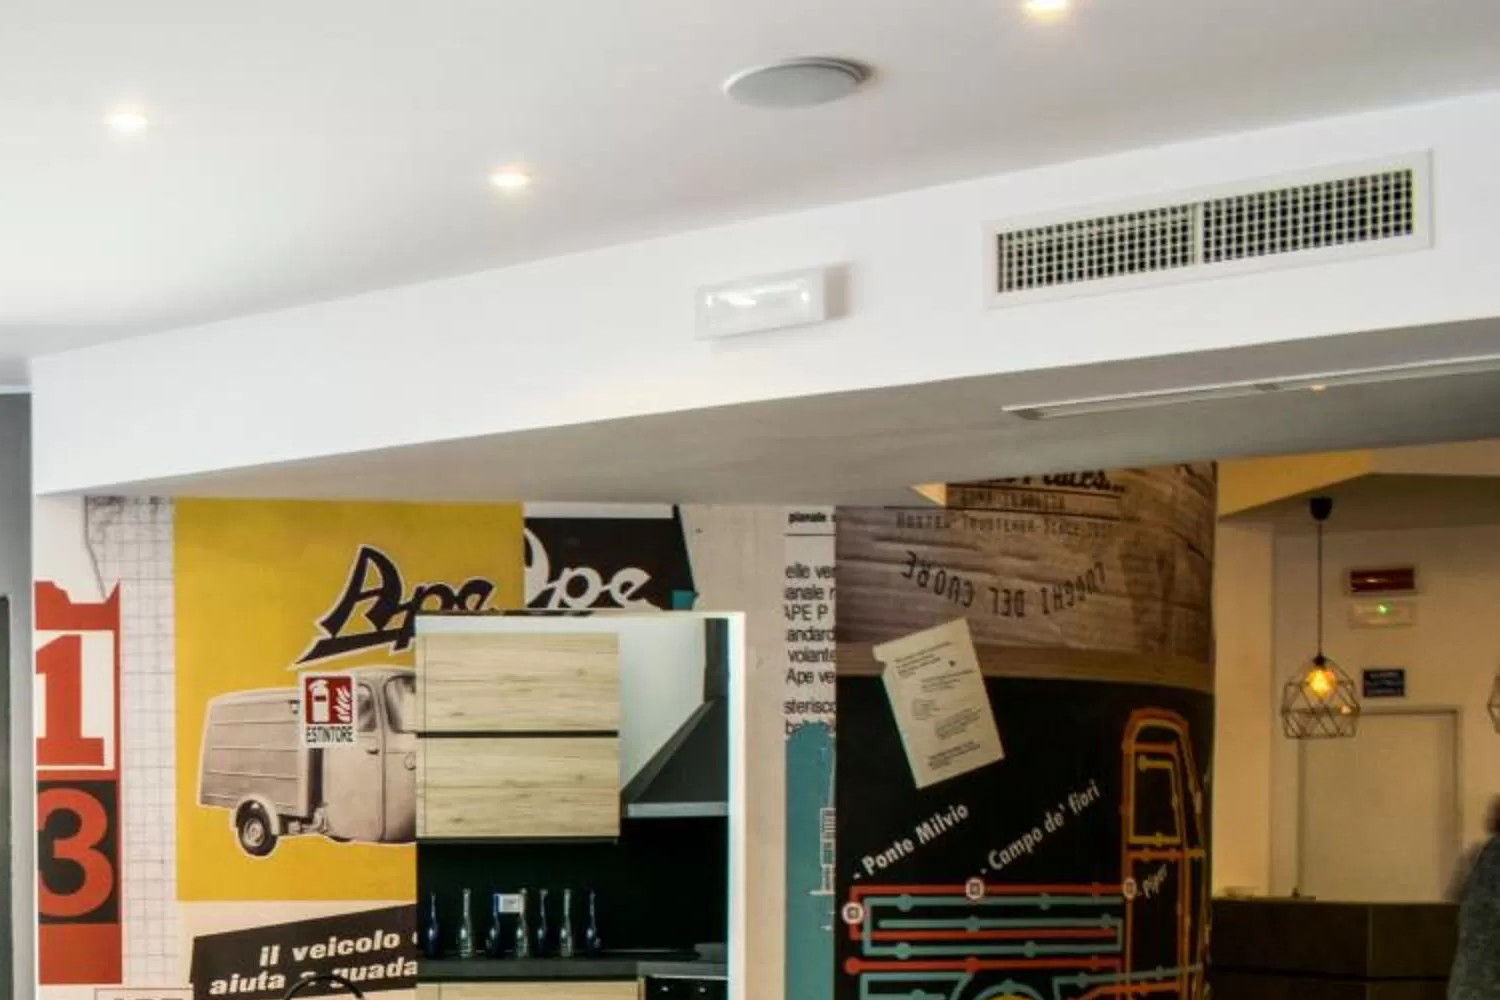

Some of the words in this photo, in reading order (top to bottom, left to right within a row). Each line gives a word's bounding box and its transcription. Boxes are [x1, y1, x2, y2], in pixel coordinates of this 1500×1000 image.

[36, 634, 105, 767] 1
[306, 725, 354, 743] ESTINTORE
[38, 787, 114, 918] 3
[861, 837, 916, 877] Ponte
[914, 802, 970, 845] Milvio
[987, 825, 1044, 871] Campo
[291, 929, 400, 962] veicolo
[208, 970, 287, 996] aiuta
